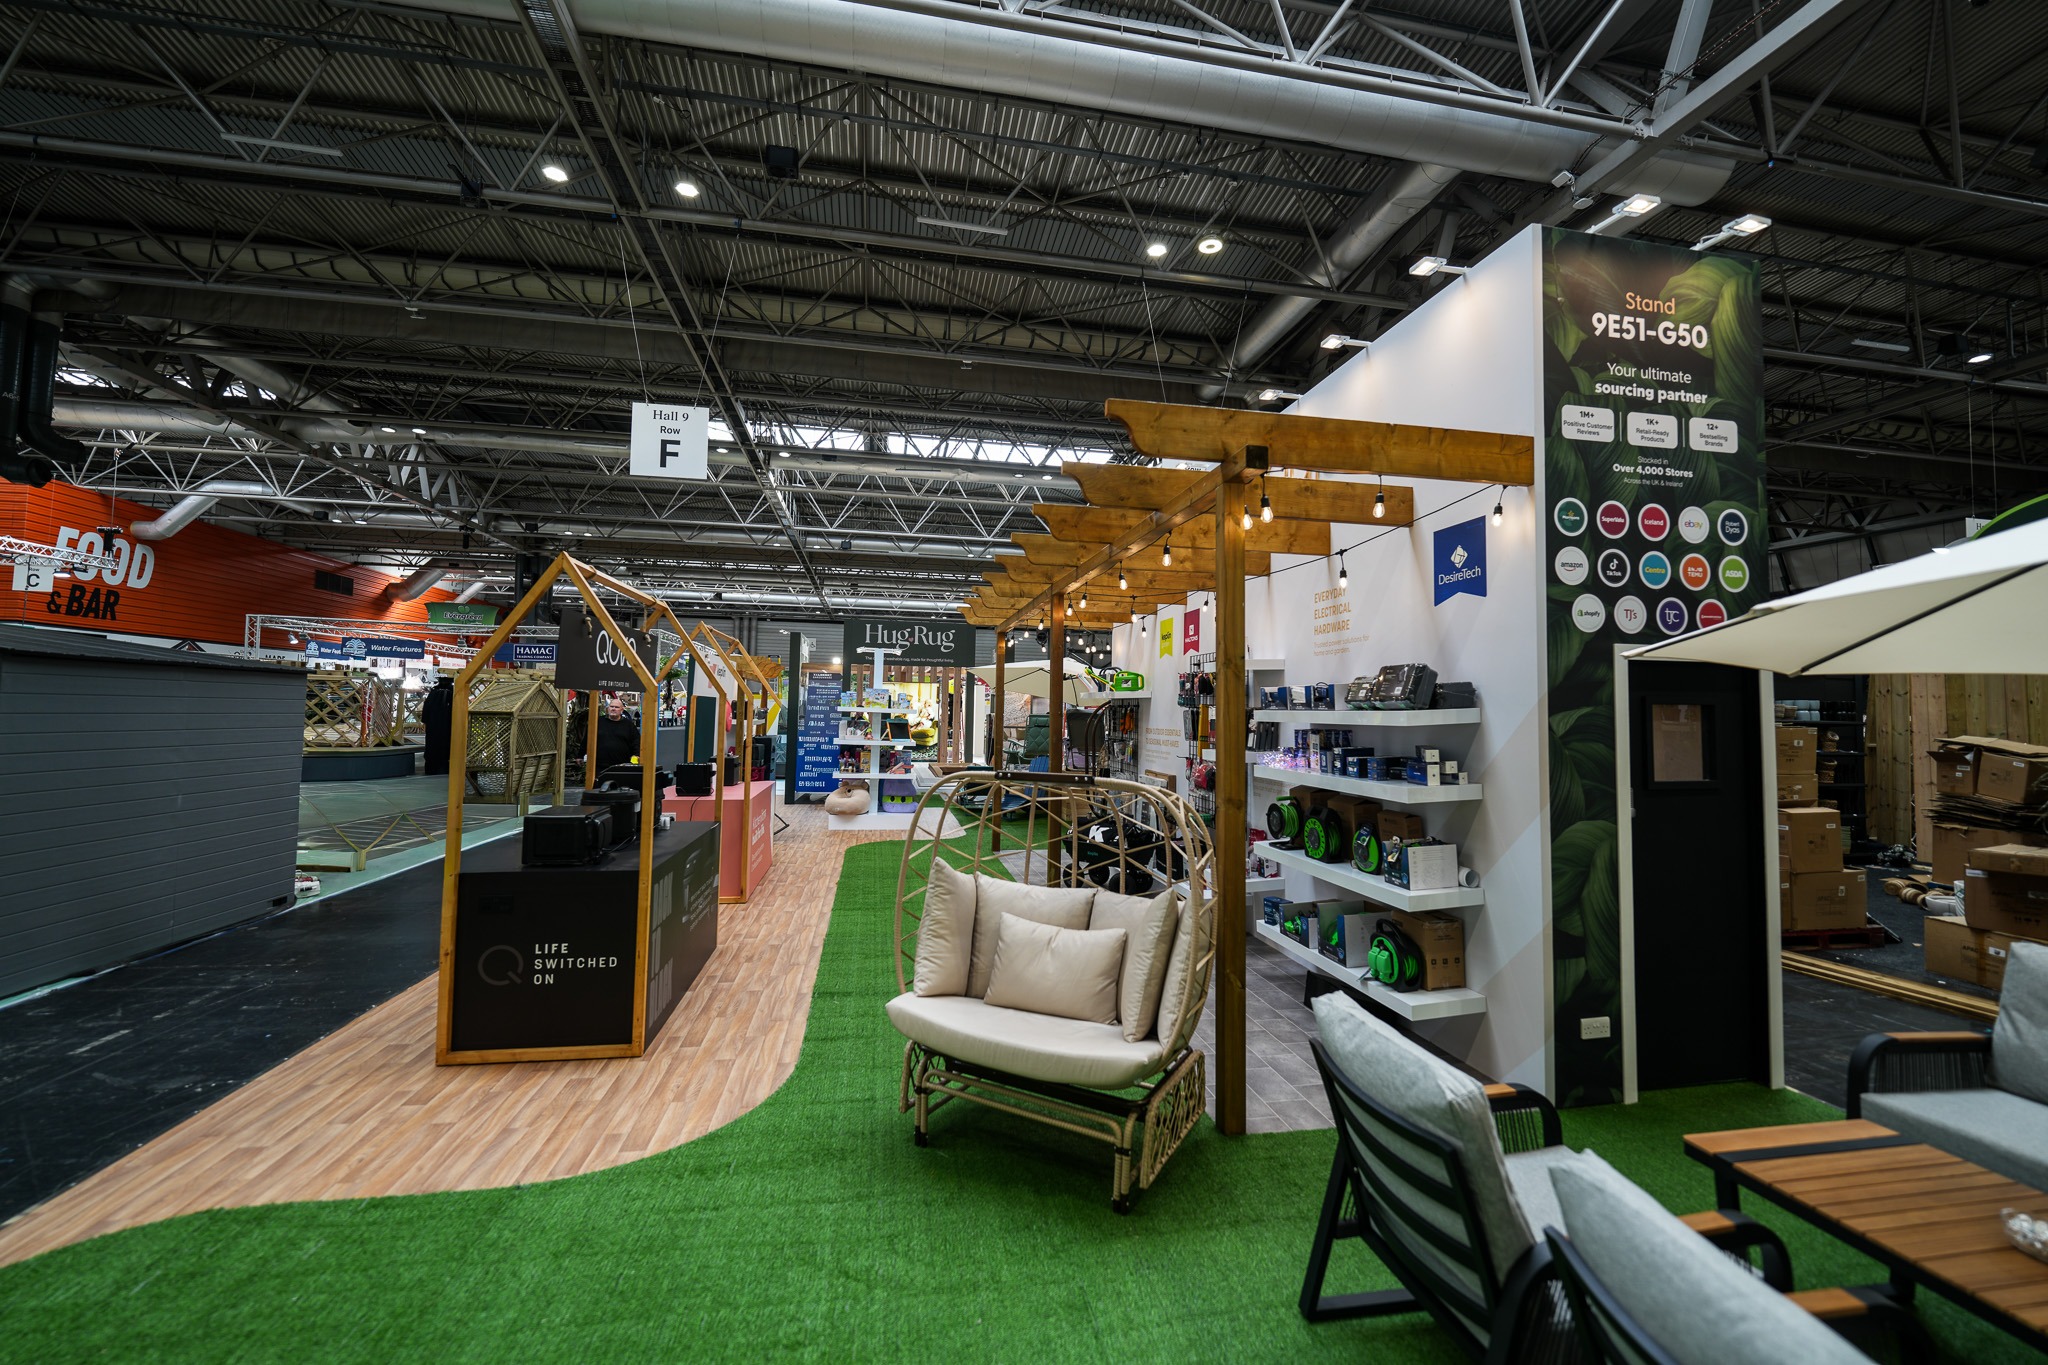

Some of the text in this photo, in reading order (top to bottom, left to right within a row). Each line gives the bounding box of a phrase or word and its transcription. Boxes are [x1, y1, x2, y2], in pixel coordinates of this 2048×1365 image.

[1625, 291, 1676, 315] Stand
[1591, 312, 1708, 349] 9E51-G50
[1606, 362, 1692, 384] Your ultimate
[1594, 382, 1708, 404] sourcing partner
[652, 409, 689, 421] Hall 9
[1579, 410, 1594, 419] 1M+
[1563, 420, 1613, 430] Positive Customer
[1645, 418, 1660, 426] 1K+
[660, 425, 681, 434] Row
[1576, 428, 1600, 437] Reviews
[1635, 427, 1670, 438] Retail-Ready
[1640, 434, 1665, 444] Products
[1699, 432, 1728, 442] Bestselling
[1704, 439, 1723, 447] Brands
[660, 439, 681, 468] F
[1637, 455, 1662, 465] Stocked
[1612, 463, 1694, 478] Over 4,000 Stores
[1623, 477, 1641, 485] Across
[1665, 480, 1684, 488] Ireland
[1644, 518, 1664, 526] Iceland
[1684, 520, 1703, 529] ebay
[1725, 526, 1740, 534] Dyas
[53, 525, 155, 589] FOOD
[27, 573, 40, 588] C
[1438, 566, 1481, 585] DesireTech
[1314, 588, 1347, 603] EVERYDAY
[46, 583, 120, 620] & BAR
[444, 611, 483, 620] Evergreen
[1314, 602, 1351, 619] ELECTRICAL
[1584, 610, 1600, 618] shopify
[1314, 619, 1350, 635] HARDWARE
[516, 646, 553, 655] HAMAC
[534, 943, 569, 955] LIFE
[534, 956, 618, 970] SWITCHED
[533, 973, 554, 985] ON
